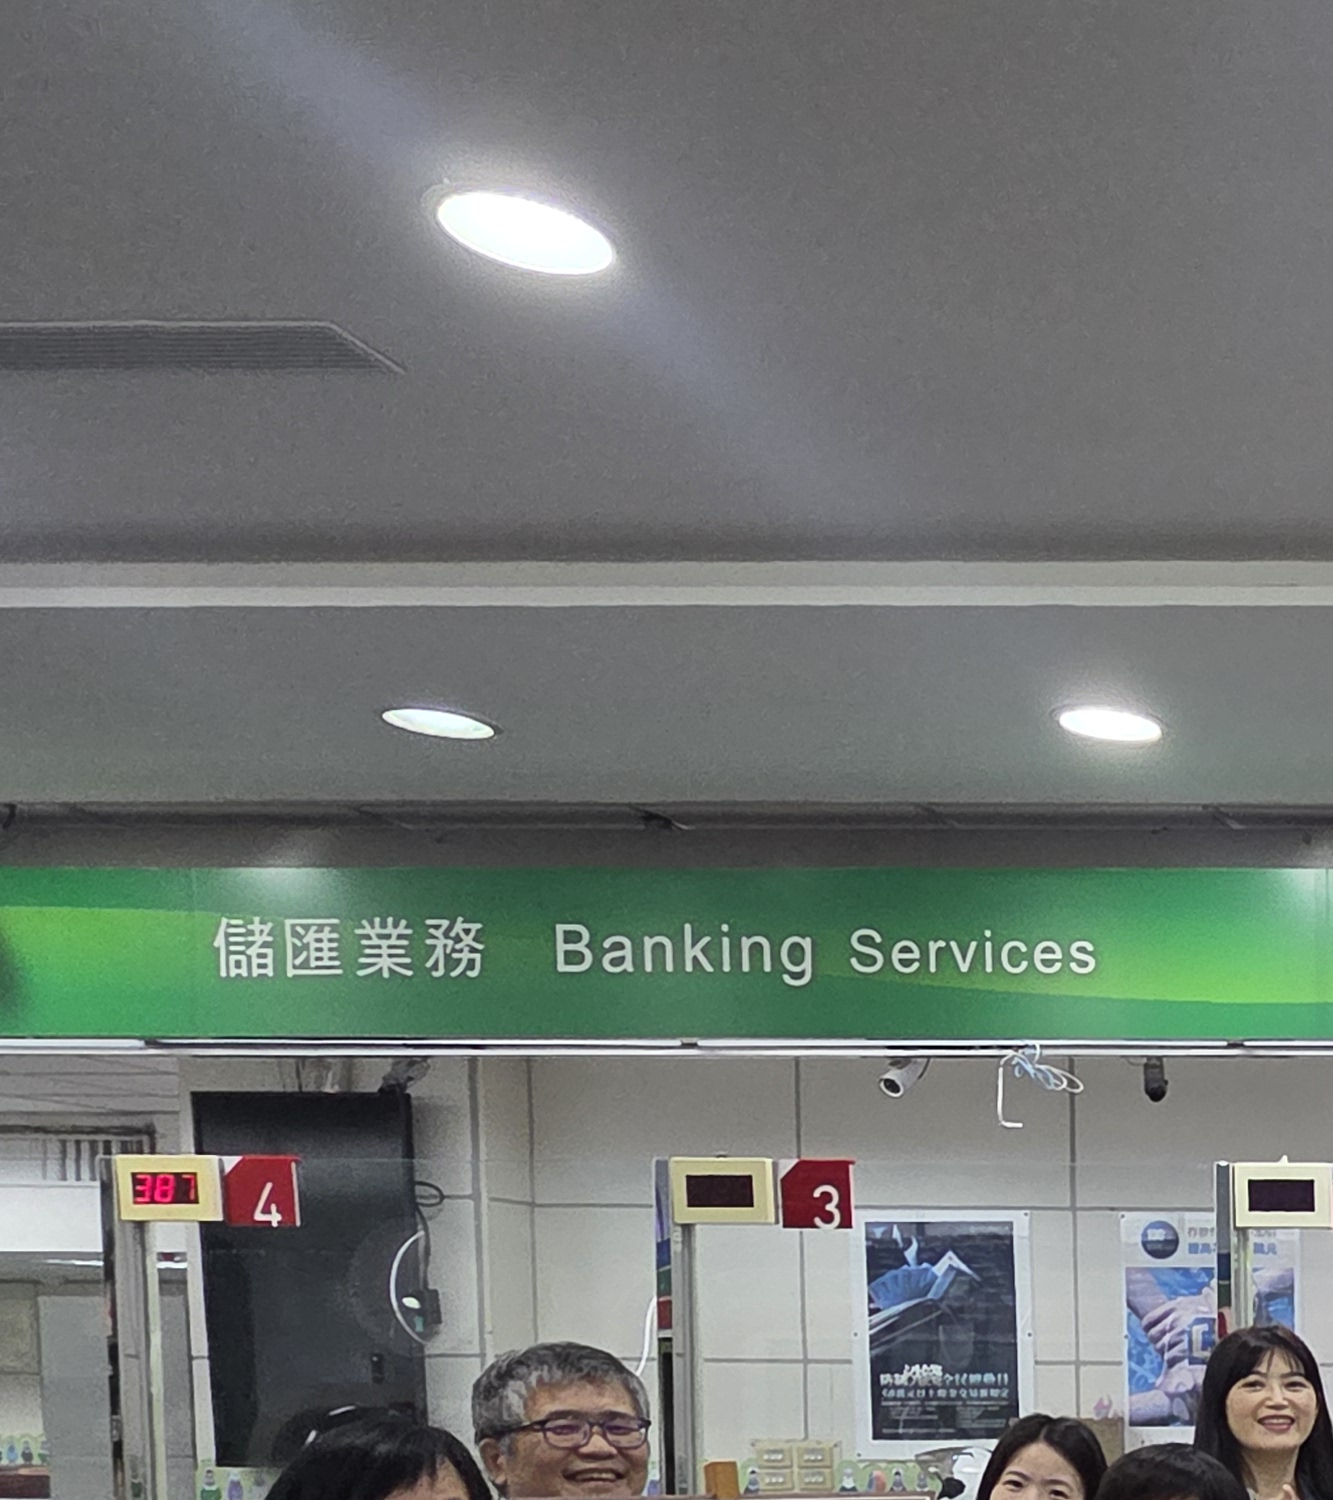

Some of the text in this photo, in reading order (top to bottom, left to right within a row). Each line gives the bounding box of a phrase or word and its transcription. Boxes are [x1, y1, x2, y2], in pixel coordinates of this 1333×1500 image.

[213, 916, 486, 979] 儲匯業務
[555, 923, 1097, 986] Banking Services
[135, 1174, 196, 1203] 387
[253, 1182, 283, 1228] 4
[812, 1183, 842, 1230] 3
